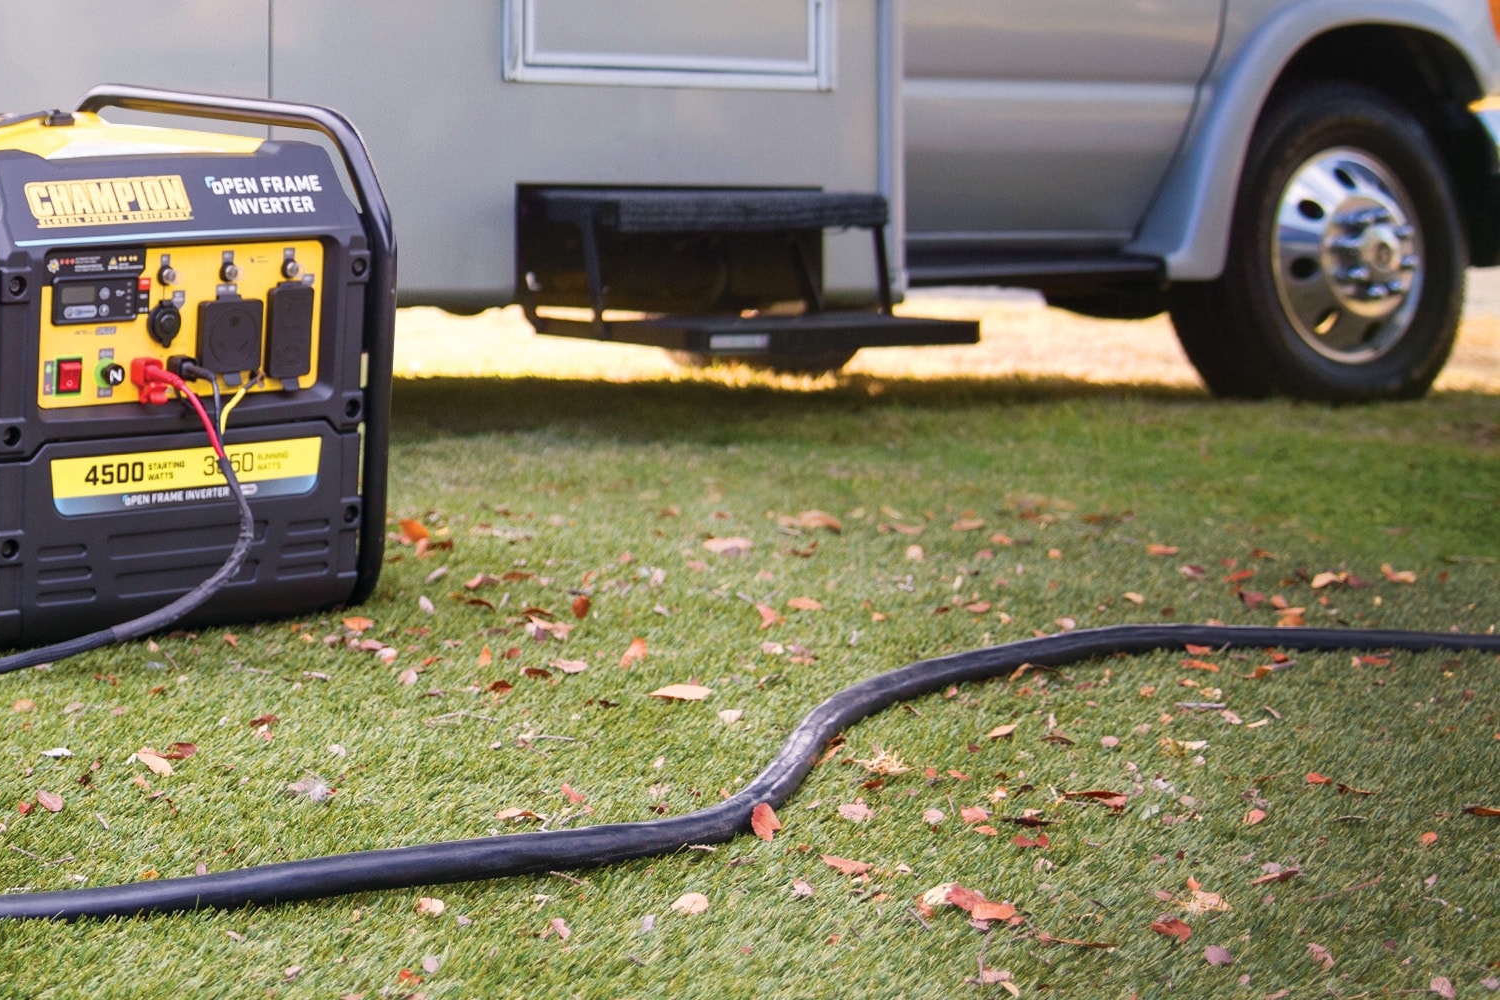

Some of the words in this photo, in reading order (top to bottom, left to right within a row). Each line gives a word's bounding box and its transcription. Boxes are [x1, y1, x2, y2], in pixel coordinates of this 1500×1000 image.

[211, 176, 259, 195] OPEN
[260, 174, 322, 193] FRAME
[28, 177, 188, 217] CHAMPION
[228, 195, 316, 216] INVERTER
[84, 461, 144, 486] 4500
[148, 460, 185, 471] STARTING
[148, 471, 174, 481] WATTS
[124, 493, 151, 506] OPEN
[151, 491, 184, 504] FRAME
[184, 486, 230, 500] INVERTER
